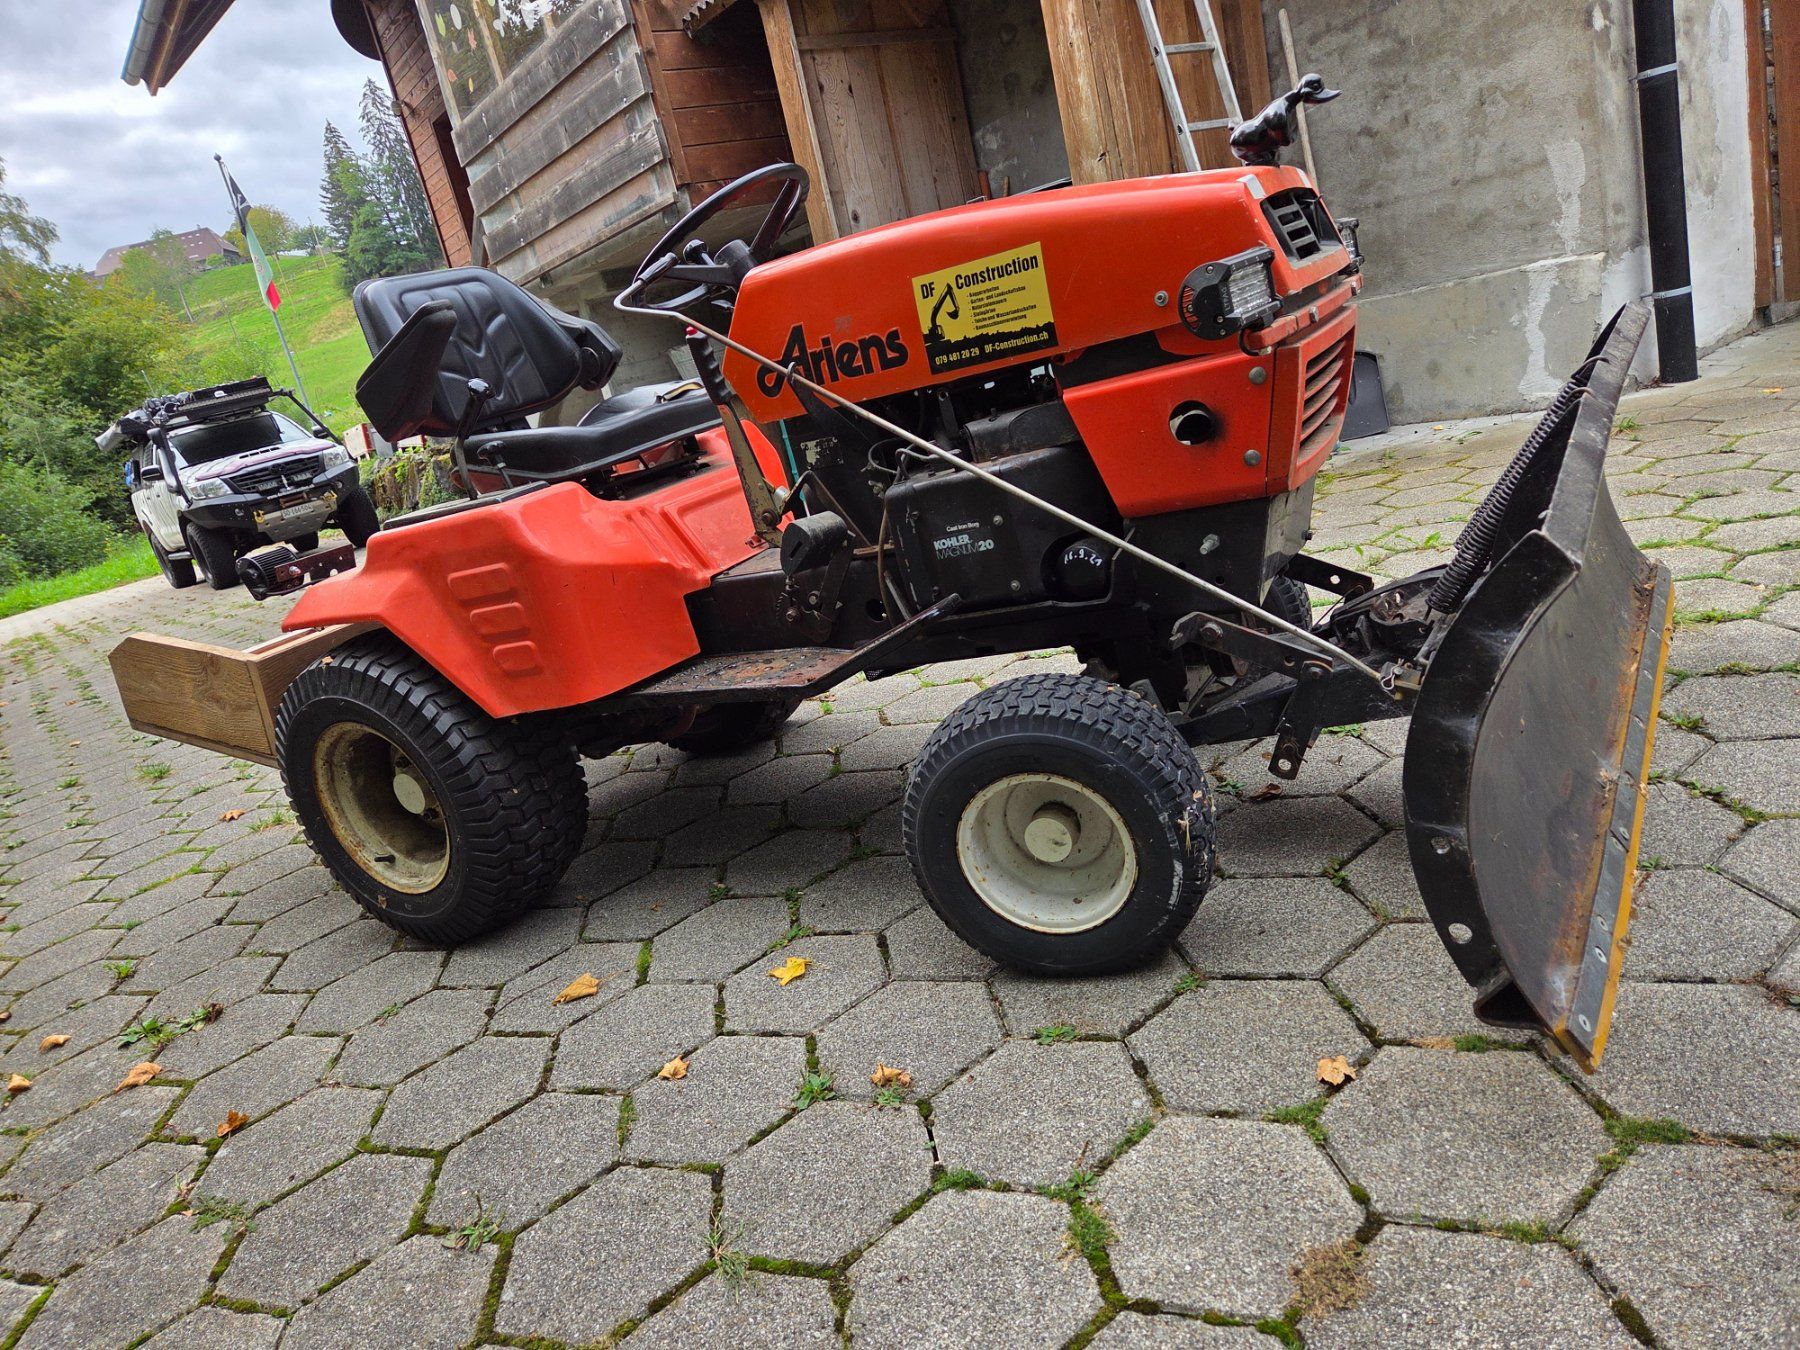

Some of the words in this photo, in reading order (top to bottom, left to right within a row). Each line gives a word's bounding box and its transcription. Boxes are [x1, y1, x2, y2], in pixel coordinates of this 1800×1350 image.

[920, 281, 936, 299] DF
[955, 255, 1039, 289] Construction
[986, 293, 995, 302] und
[756, 321, 909, 398] Ariens
[935, 353, 948, 366] 079
[949, 350, 961, 362] 481
[961, 348, 970, 359] 20
[970, 346, 980, 357] 29
[984, 330, 1049, 354] DF-Construction.ch
[933, 533, 971, 551] KOHLER
[936, 542, 979, 560] MAGNUM
